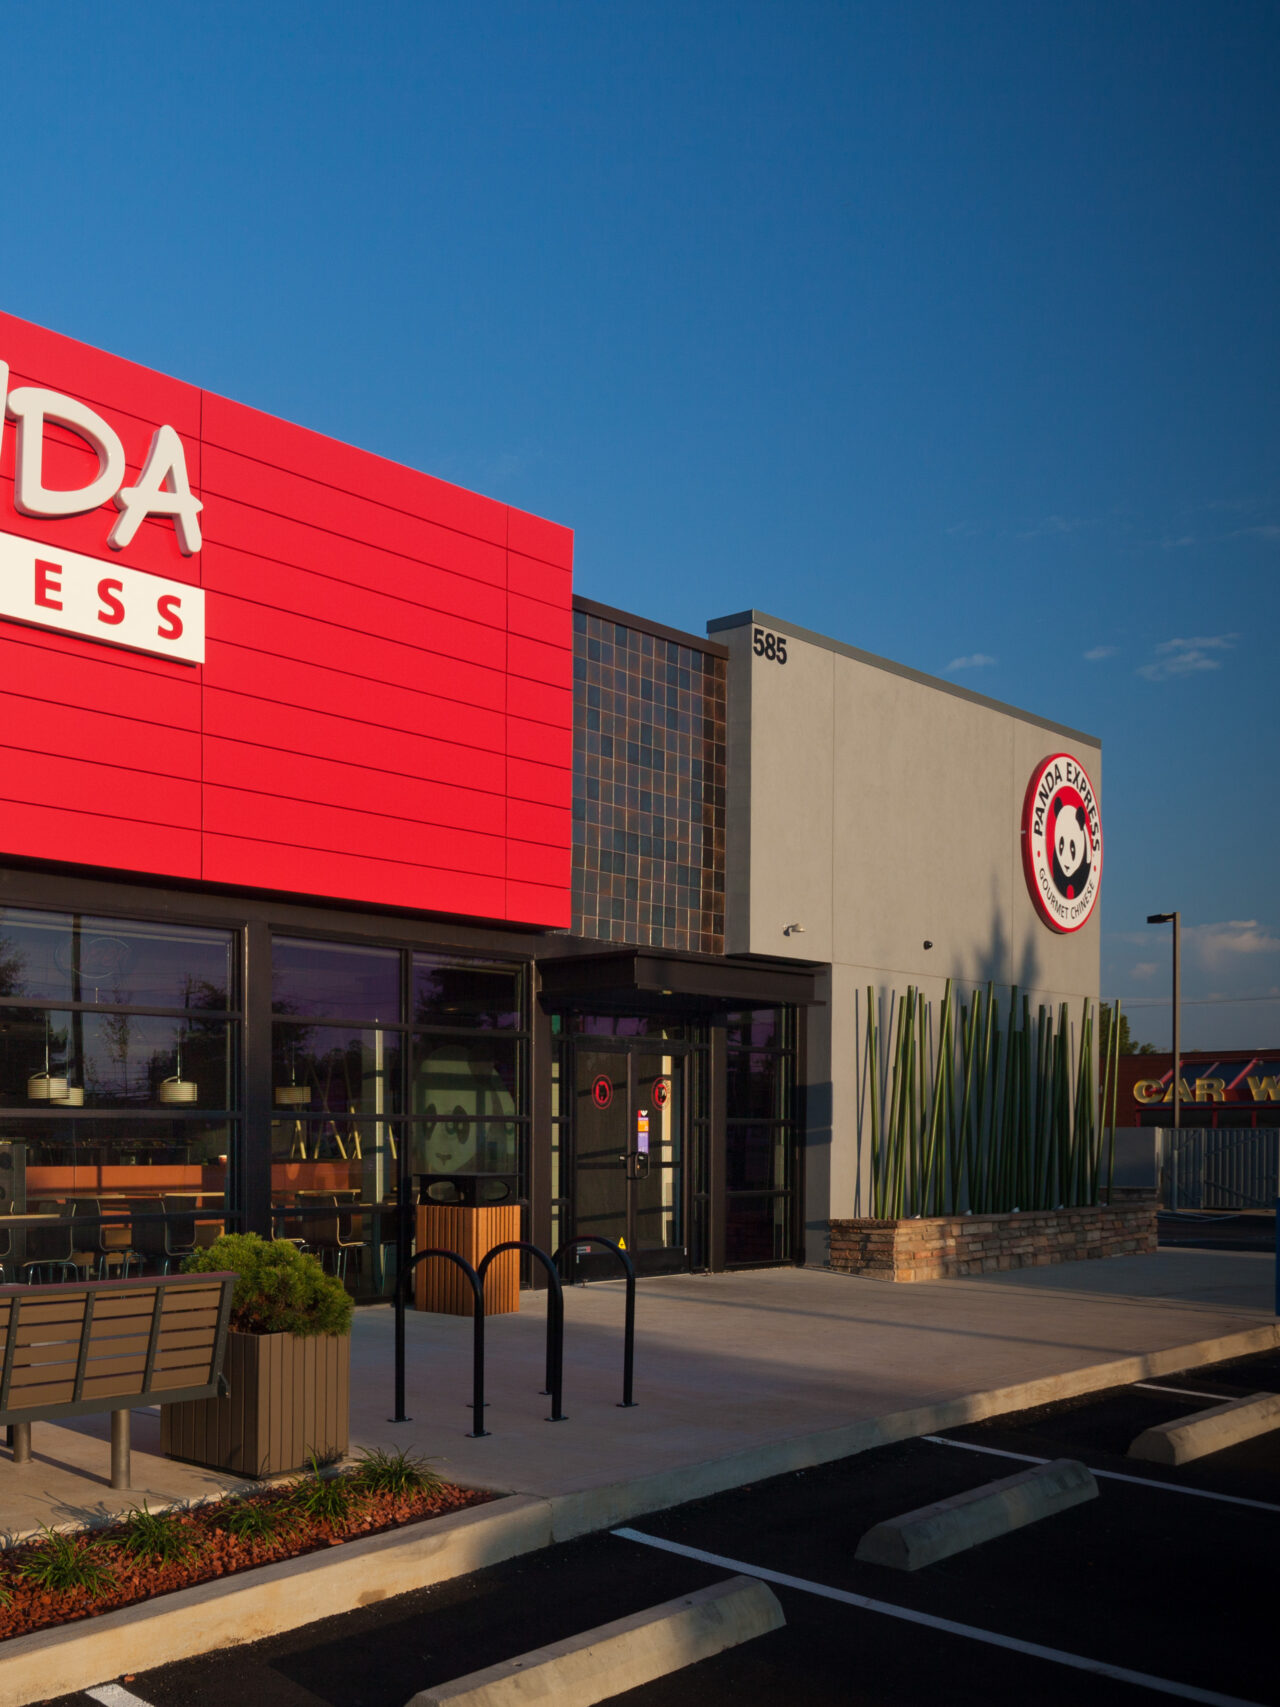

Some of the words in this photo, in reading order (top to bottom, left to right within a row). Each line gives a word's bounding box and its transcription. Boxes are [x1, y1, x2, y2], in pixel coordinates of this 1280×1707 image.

[753, 628, 787, 665] 585
[1033, 763, 1063, 837] PANDA
[1066, 761, 1100, 852] EXPRESS
[1039, 867, 1069, 921] GOURMET
[1070, 880, 1095, 920] CHINESE
[1133, 1078, 1226, 1104] CAR
